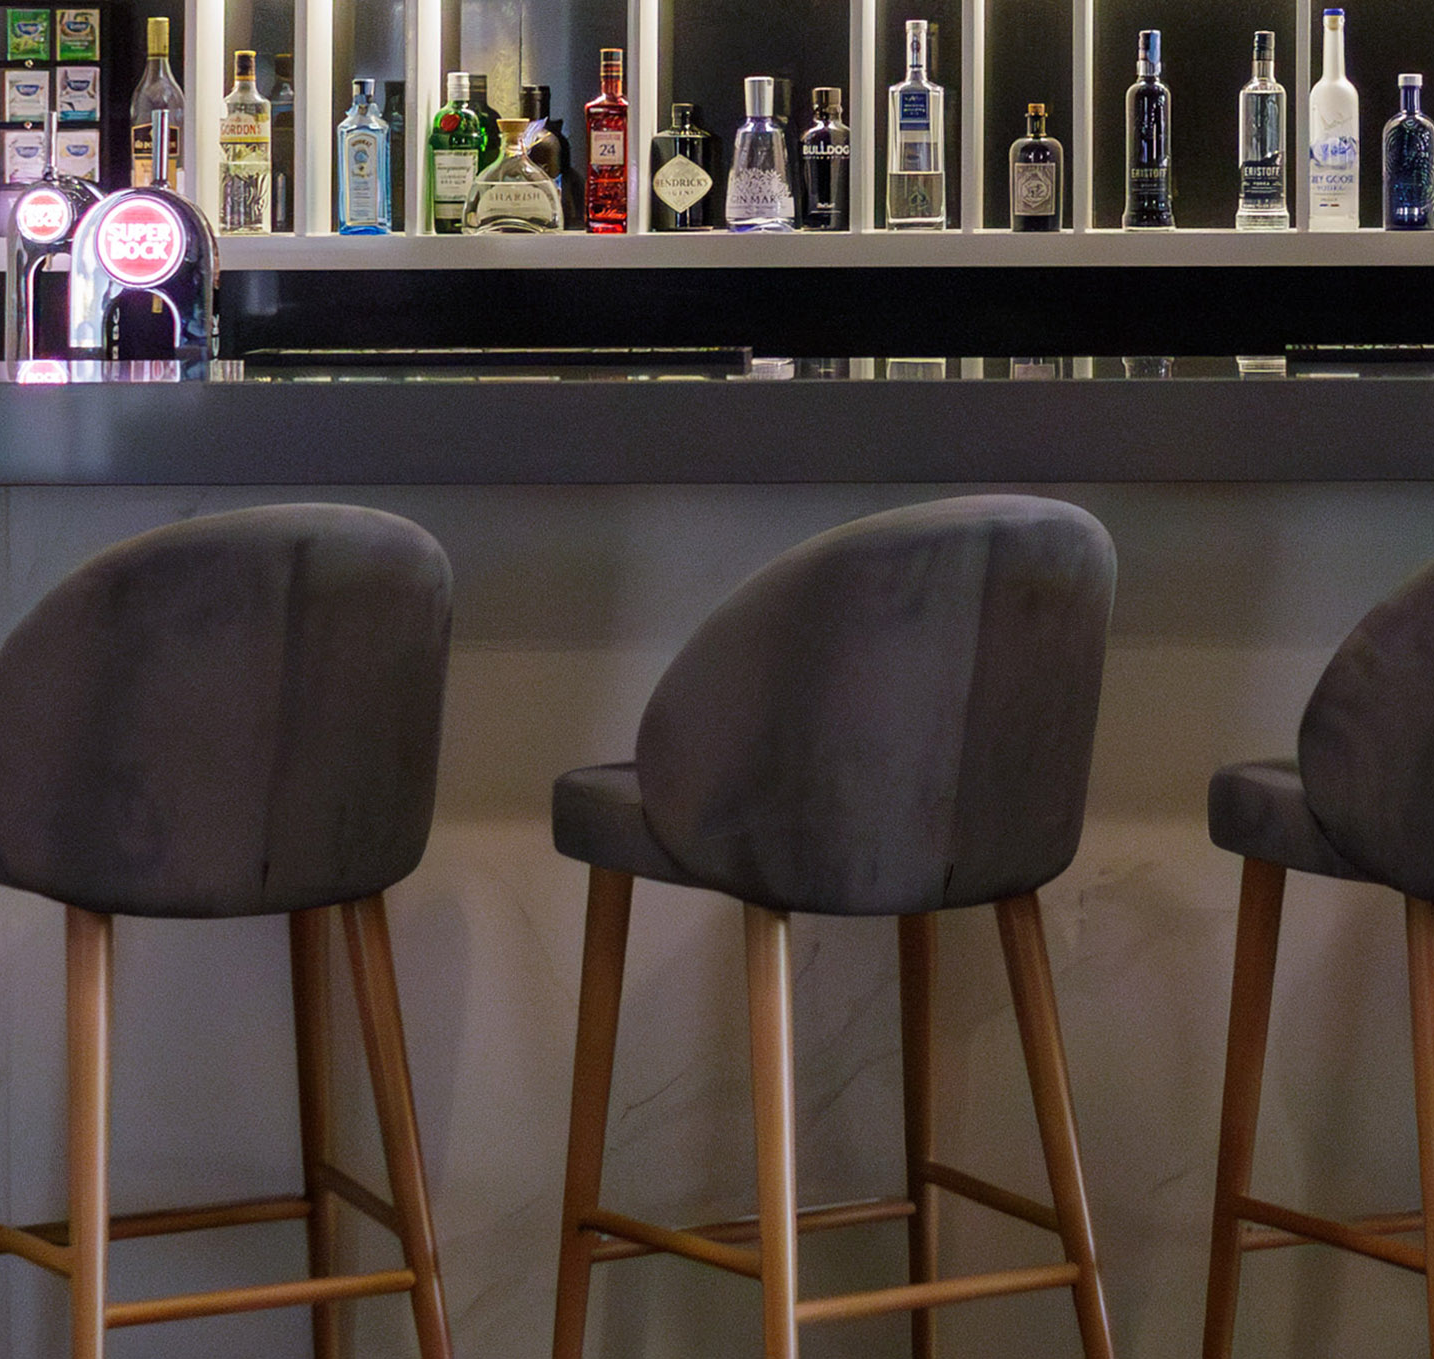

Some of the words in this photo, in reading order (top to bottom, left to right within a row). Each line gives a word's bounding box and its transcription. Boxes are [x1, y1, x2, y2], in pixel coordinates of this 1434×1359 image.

[599, 143, 616, 157] 24
[803, 142, 850, 155] BULLDOG
[1244, 167, 1280, 177] ERISTOFF
[107, 222, 172, 242] SUPER
[110, 240, 170, 260] BOCK
